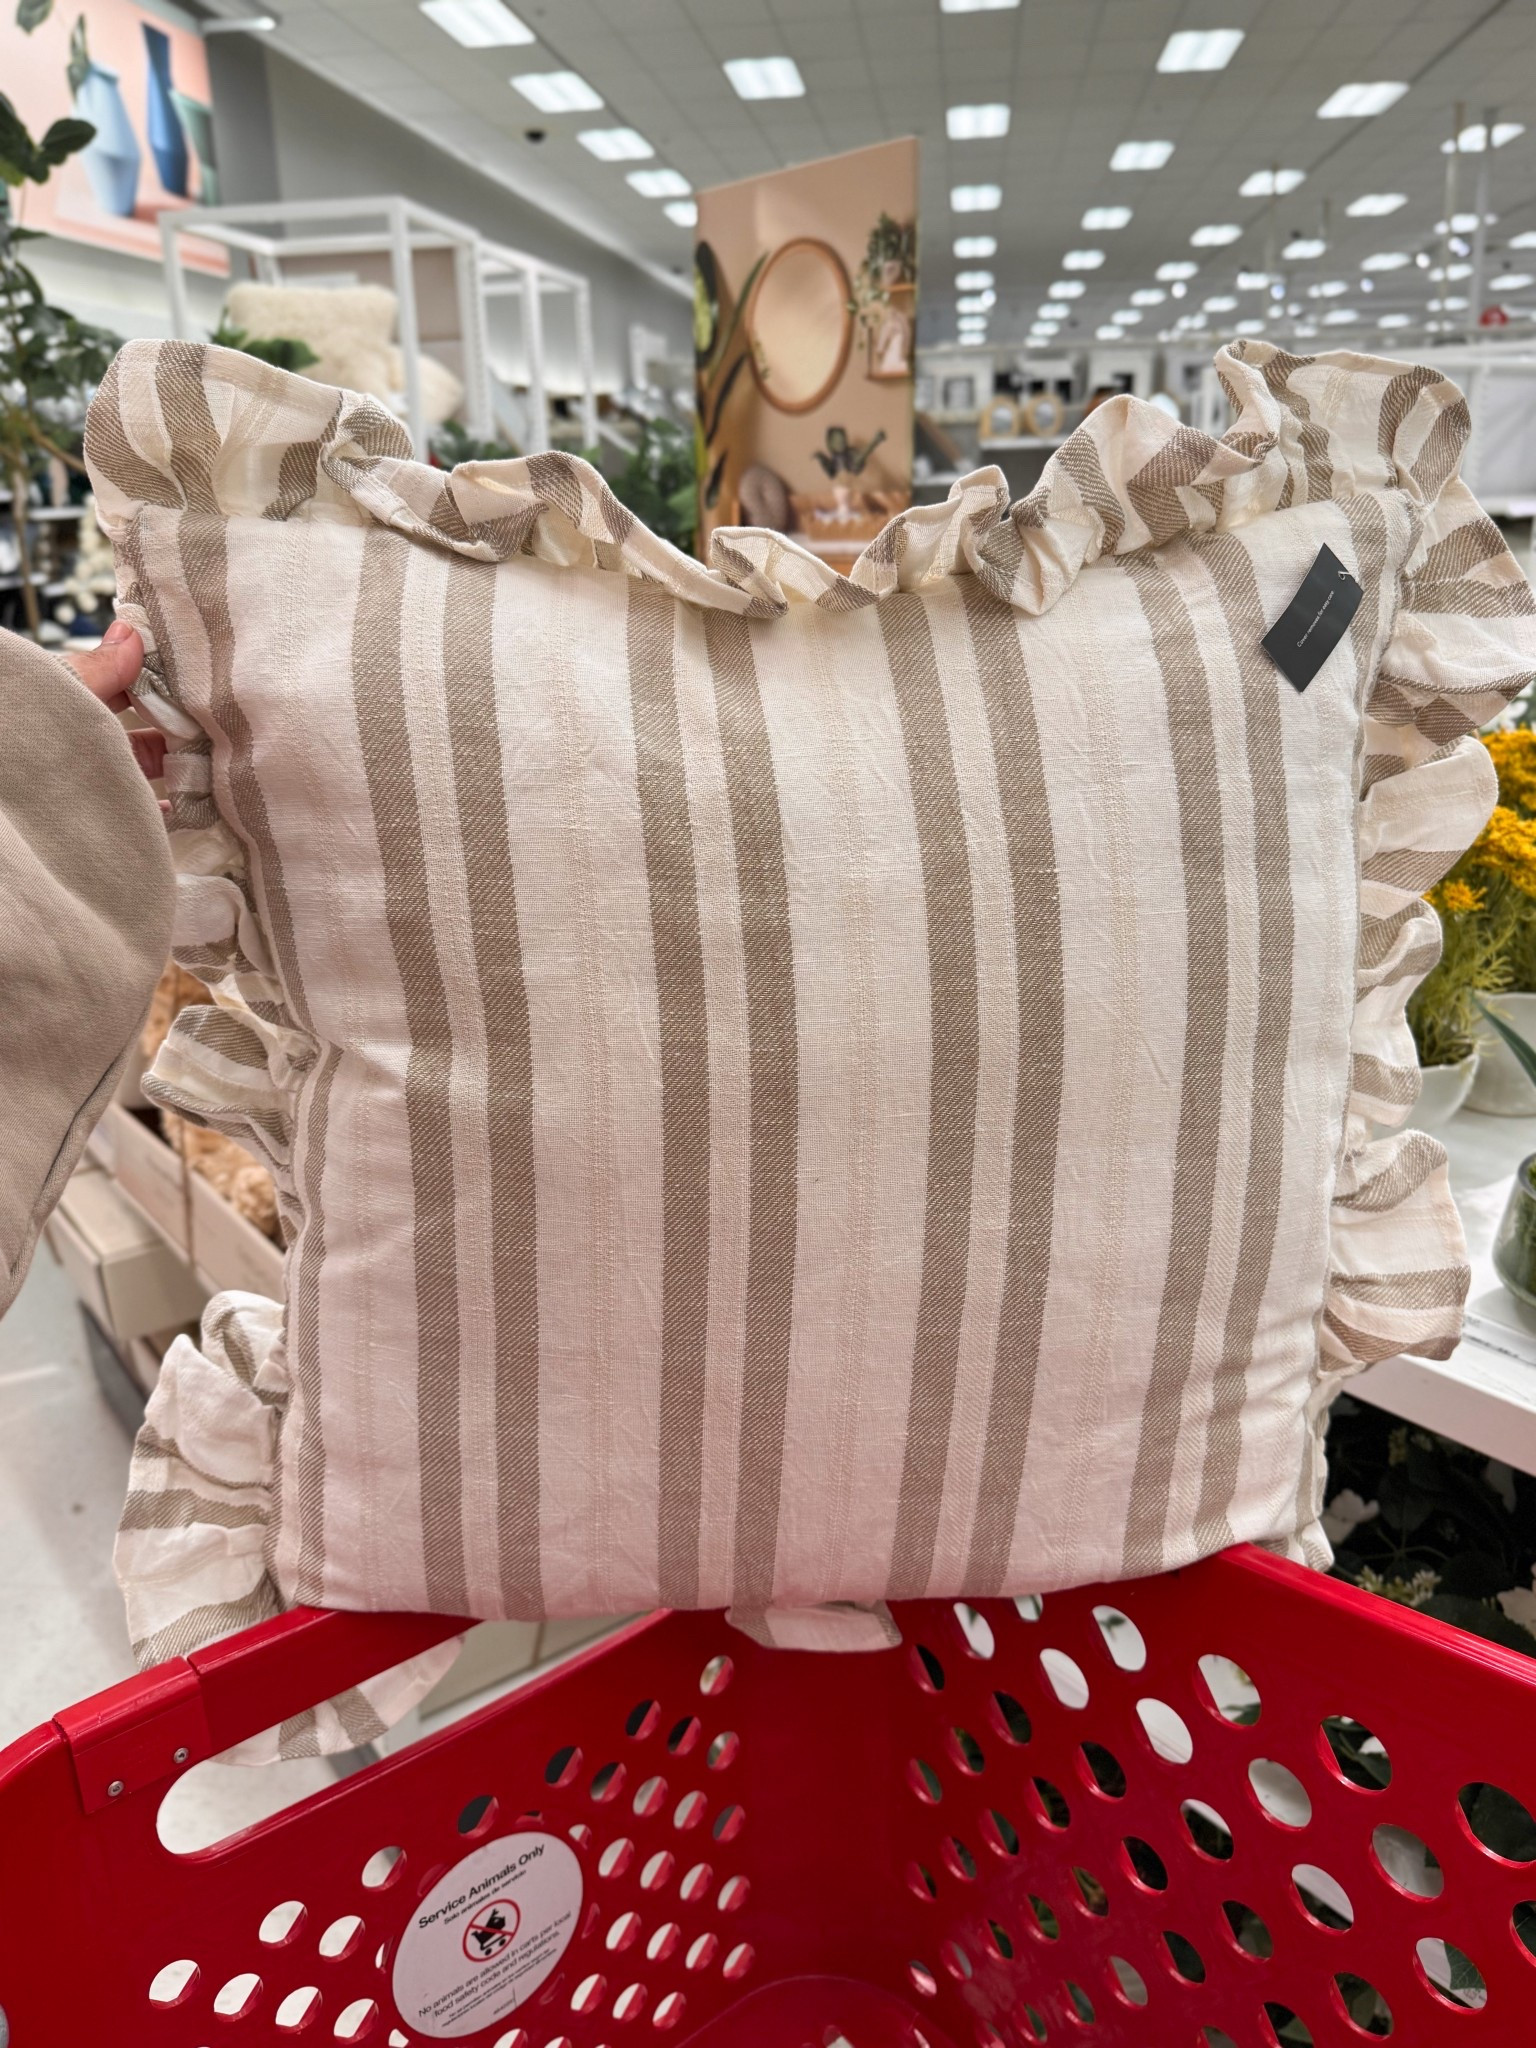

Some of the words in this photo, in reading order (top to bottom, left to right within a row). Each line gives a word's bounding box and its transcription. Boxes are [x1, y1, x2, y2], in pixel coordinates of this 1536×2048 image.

[1297, 633, 1308, 647] Cover
[419, 1895, 466, 1928] Service
[469, 1862, 516, 1899] Animals
[519, 1844, 545, 1866] Only
[461, 1892, 491, 1915] animales
[492, 1886, 500, 1894] de
[502, 1870, 526, 1888] servicio
[419, 2005, 432, 2017] No
[433, 1985, 464, 2008] animals
[466, 1975, 479, 1987] are
[480, 1953, 510, 1977] allowed
[511, 1948, 518, 1957] in
[520, 1934, 539, 1951] carts
[540, 1925, 552, 1938] per
[554, 1911, 571, 1926] local
[434, 2000, 453, 2017] food
[455, 1985, 479, 2004] safety
[481, 1971, 501, 1987] code
[502, 1958, 517, 1973] and
